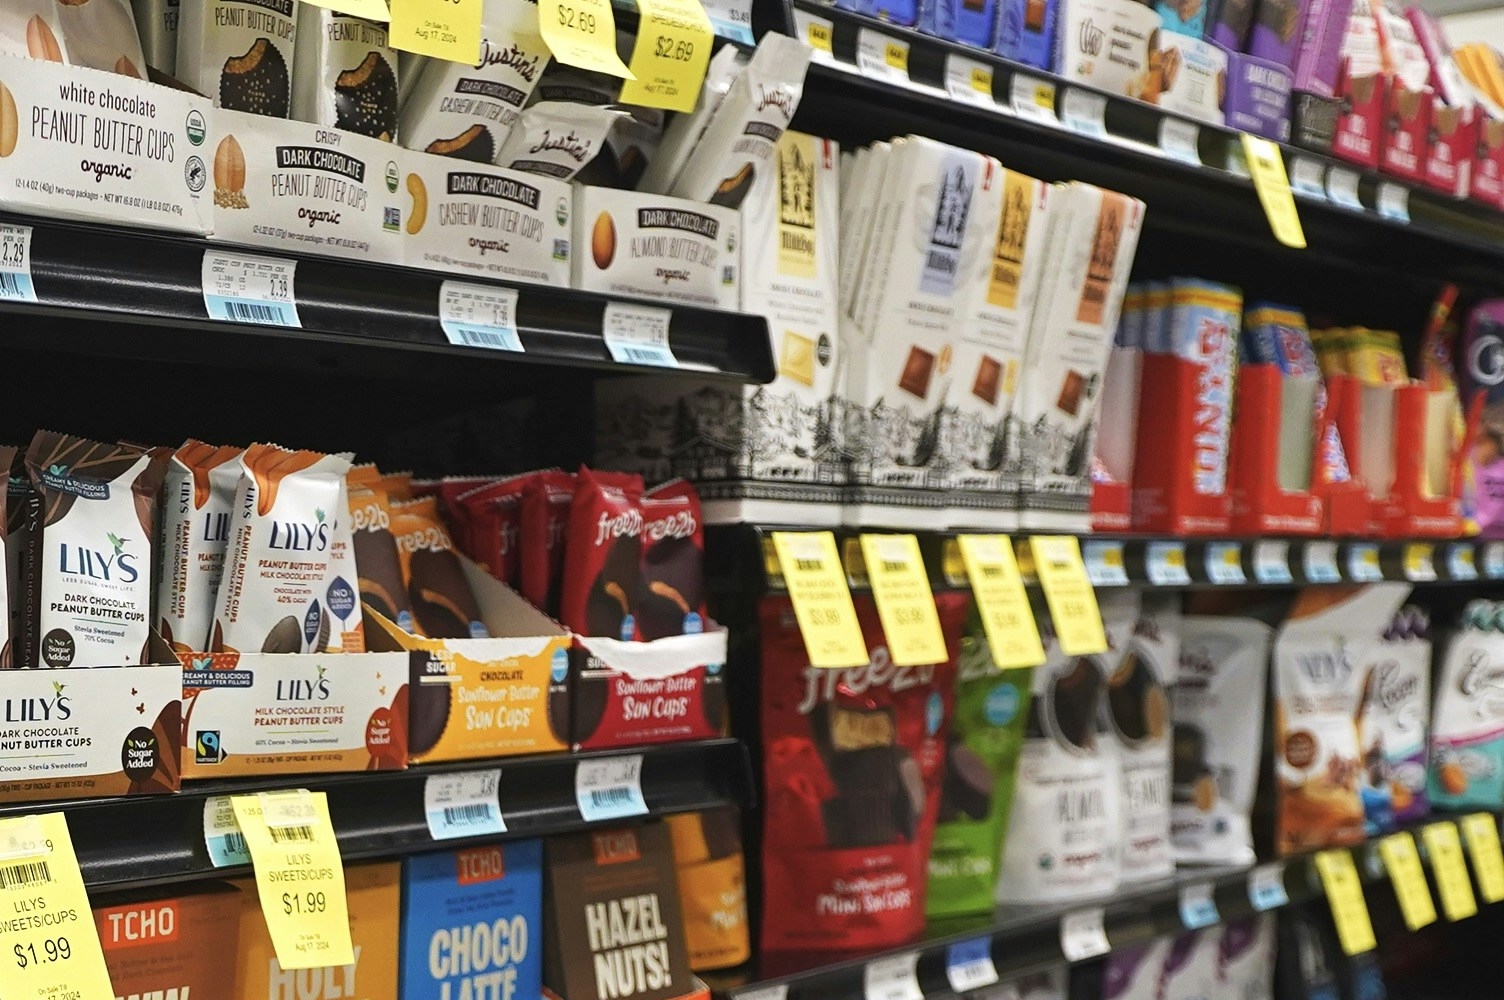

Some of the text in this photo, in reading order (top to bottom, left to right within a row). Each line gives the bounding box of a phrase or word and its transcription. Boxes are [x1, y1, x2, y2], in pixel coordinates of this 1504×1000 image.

[558, 4, 596, 35] $2.69
[655, 35, 694, 62] $2.69
[59, 82, 156, 119] white chocolate
[81, 159, 132, 182] organic
[283, 150, 362, 177] DARK CHOCOLATE
[298, 207, 341, 227] organic
[439, 203, 544, 243] CASHEW BUTTER CUPS
[643, 210, 718, 237] DARK CHOCOLATE
[258, 559, 327, 571] PEANUT BUTTER CUPS
[51, 602, 145, 622] PEANUT BUTTER CUPS
[65, 594, 135, 609] DARK CHOCOLATE
[616, 677, 697, 695] Sunflower Butter
[623, 696, 691, 721] Sun Cups
[24, 727, 80, 737] CHOCOLATE
[25, 739, 63, 749] BUTTER
[65, 737, 92, 748] CUPS
[282, 892, 326, 916] $1.99
[585, 893, 668, 953] HAZEL
[593, 942, 673, 1000] NUTS!
